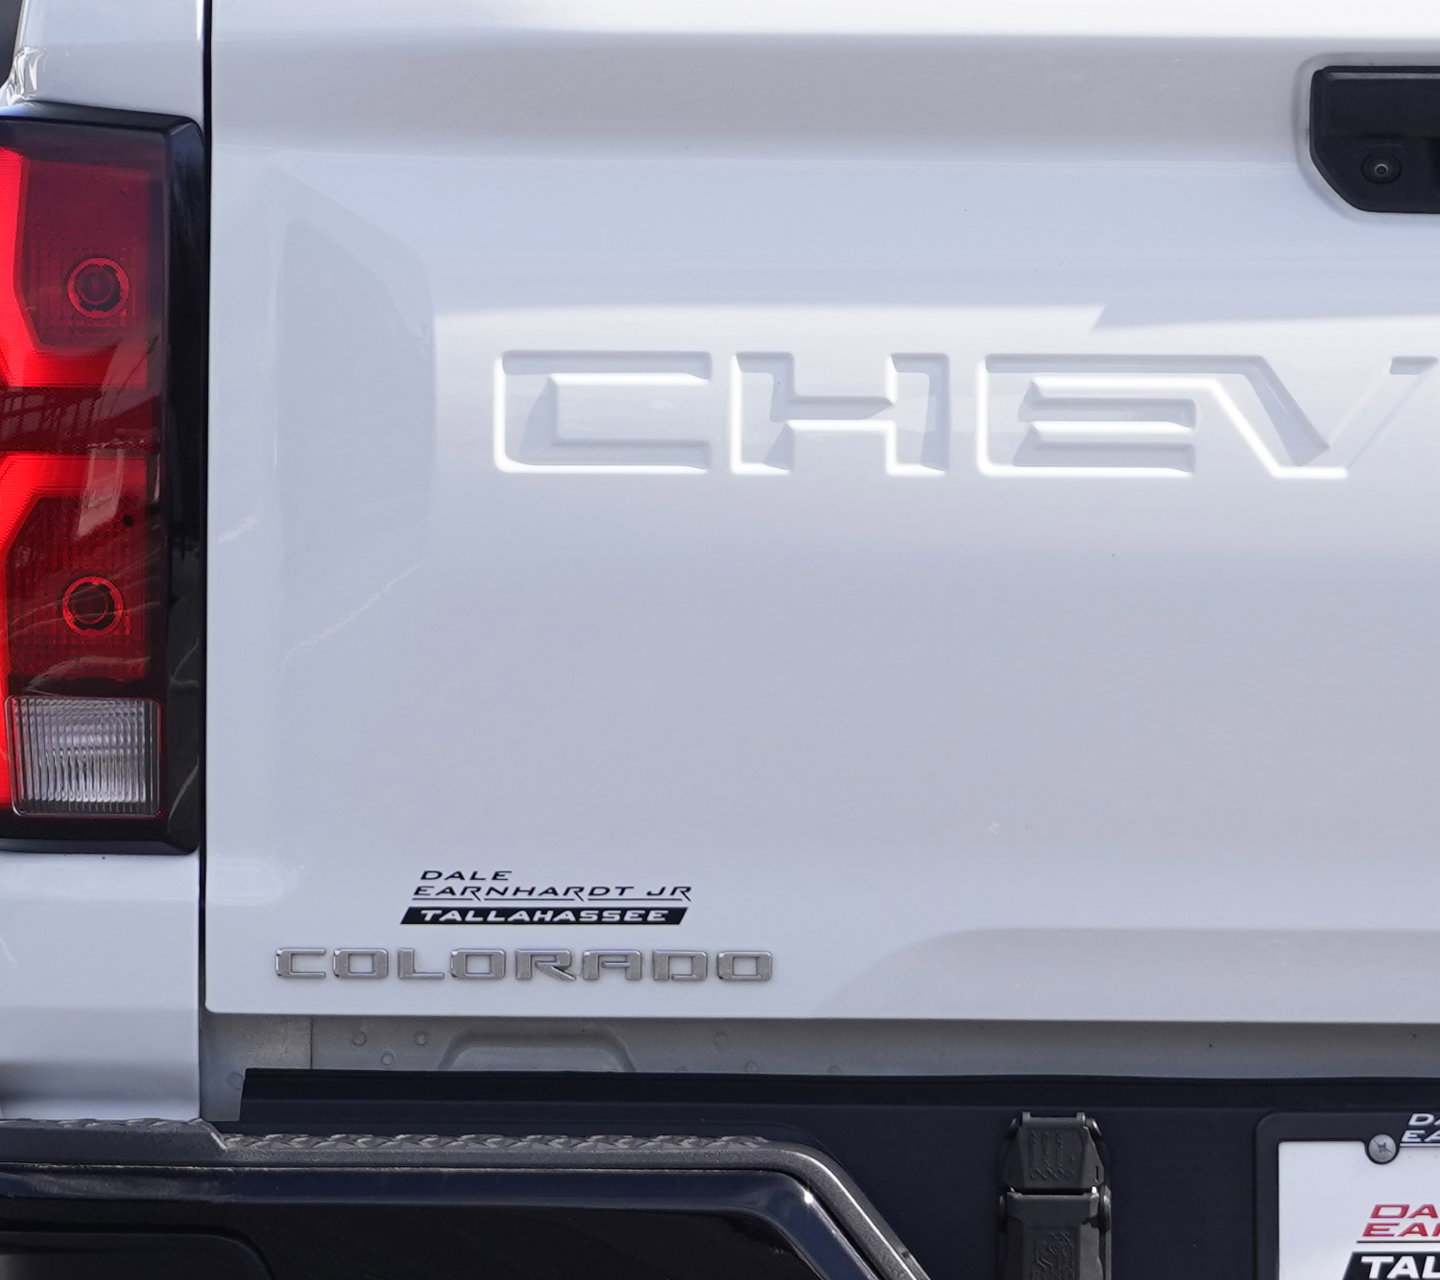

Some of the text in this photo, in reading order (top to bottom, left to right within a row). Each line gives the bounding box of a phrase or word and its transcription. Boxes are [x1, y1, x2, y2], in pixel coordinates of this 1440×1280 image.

[420, 870, 512, 881] DALE
[413, 885, 693, 902] EARNHARDT JR
[419, 909, 670, 923] TALLAHASSEE
[274, 946, 774, 983] COLORADO
